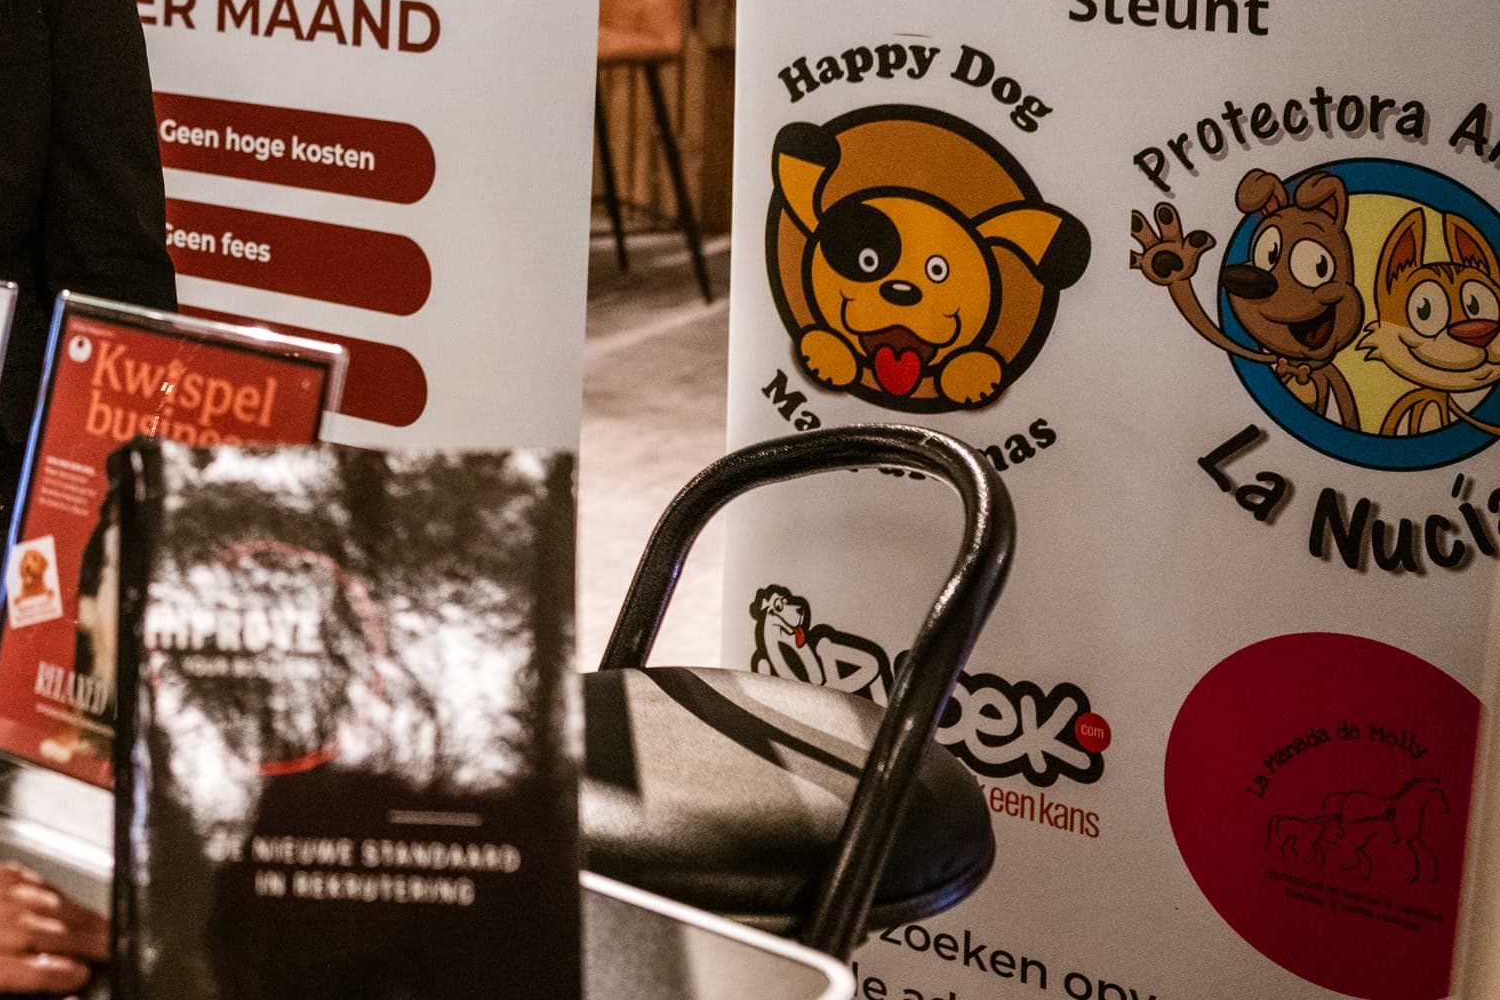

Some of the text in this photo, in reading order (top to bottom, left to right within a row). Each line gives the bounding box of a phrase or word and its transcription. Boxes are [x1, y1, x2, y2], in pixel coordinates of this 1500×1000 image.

[778, 41, 1054, 134] Happy Dog
[160, 119, 375, 172] Geen hoge kosten
[1133, 86, 1500, 193] Protectora A
[166, 223, 271, 263] Geen fees
[92, 339, 277, 427] Kwispel
[1197, 424, 1287, 521] La
[1246, 720, 1428, 799] La Manada de Molly
[990, 786, 1101, 838] een kans
[879, 923, 1048, 990] zoeken
